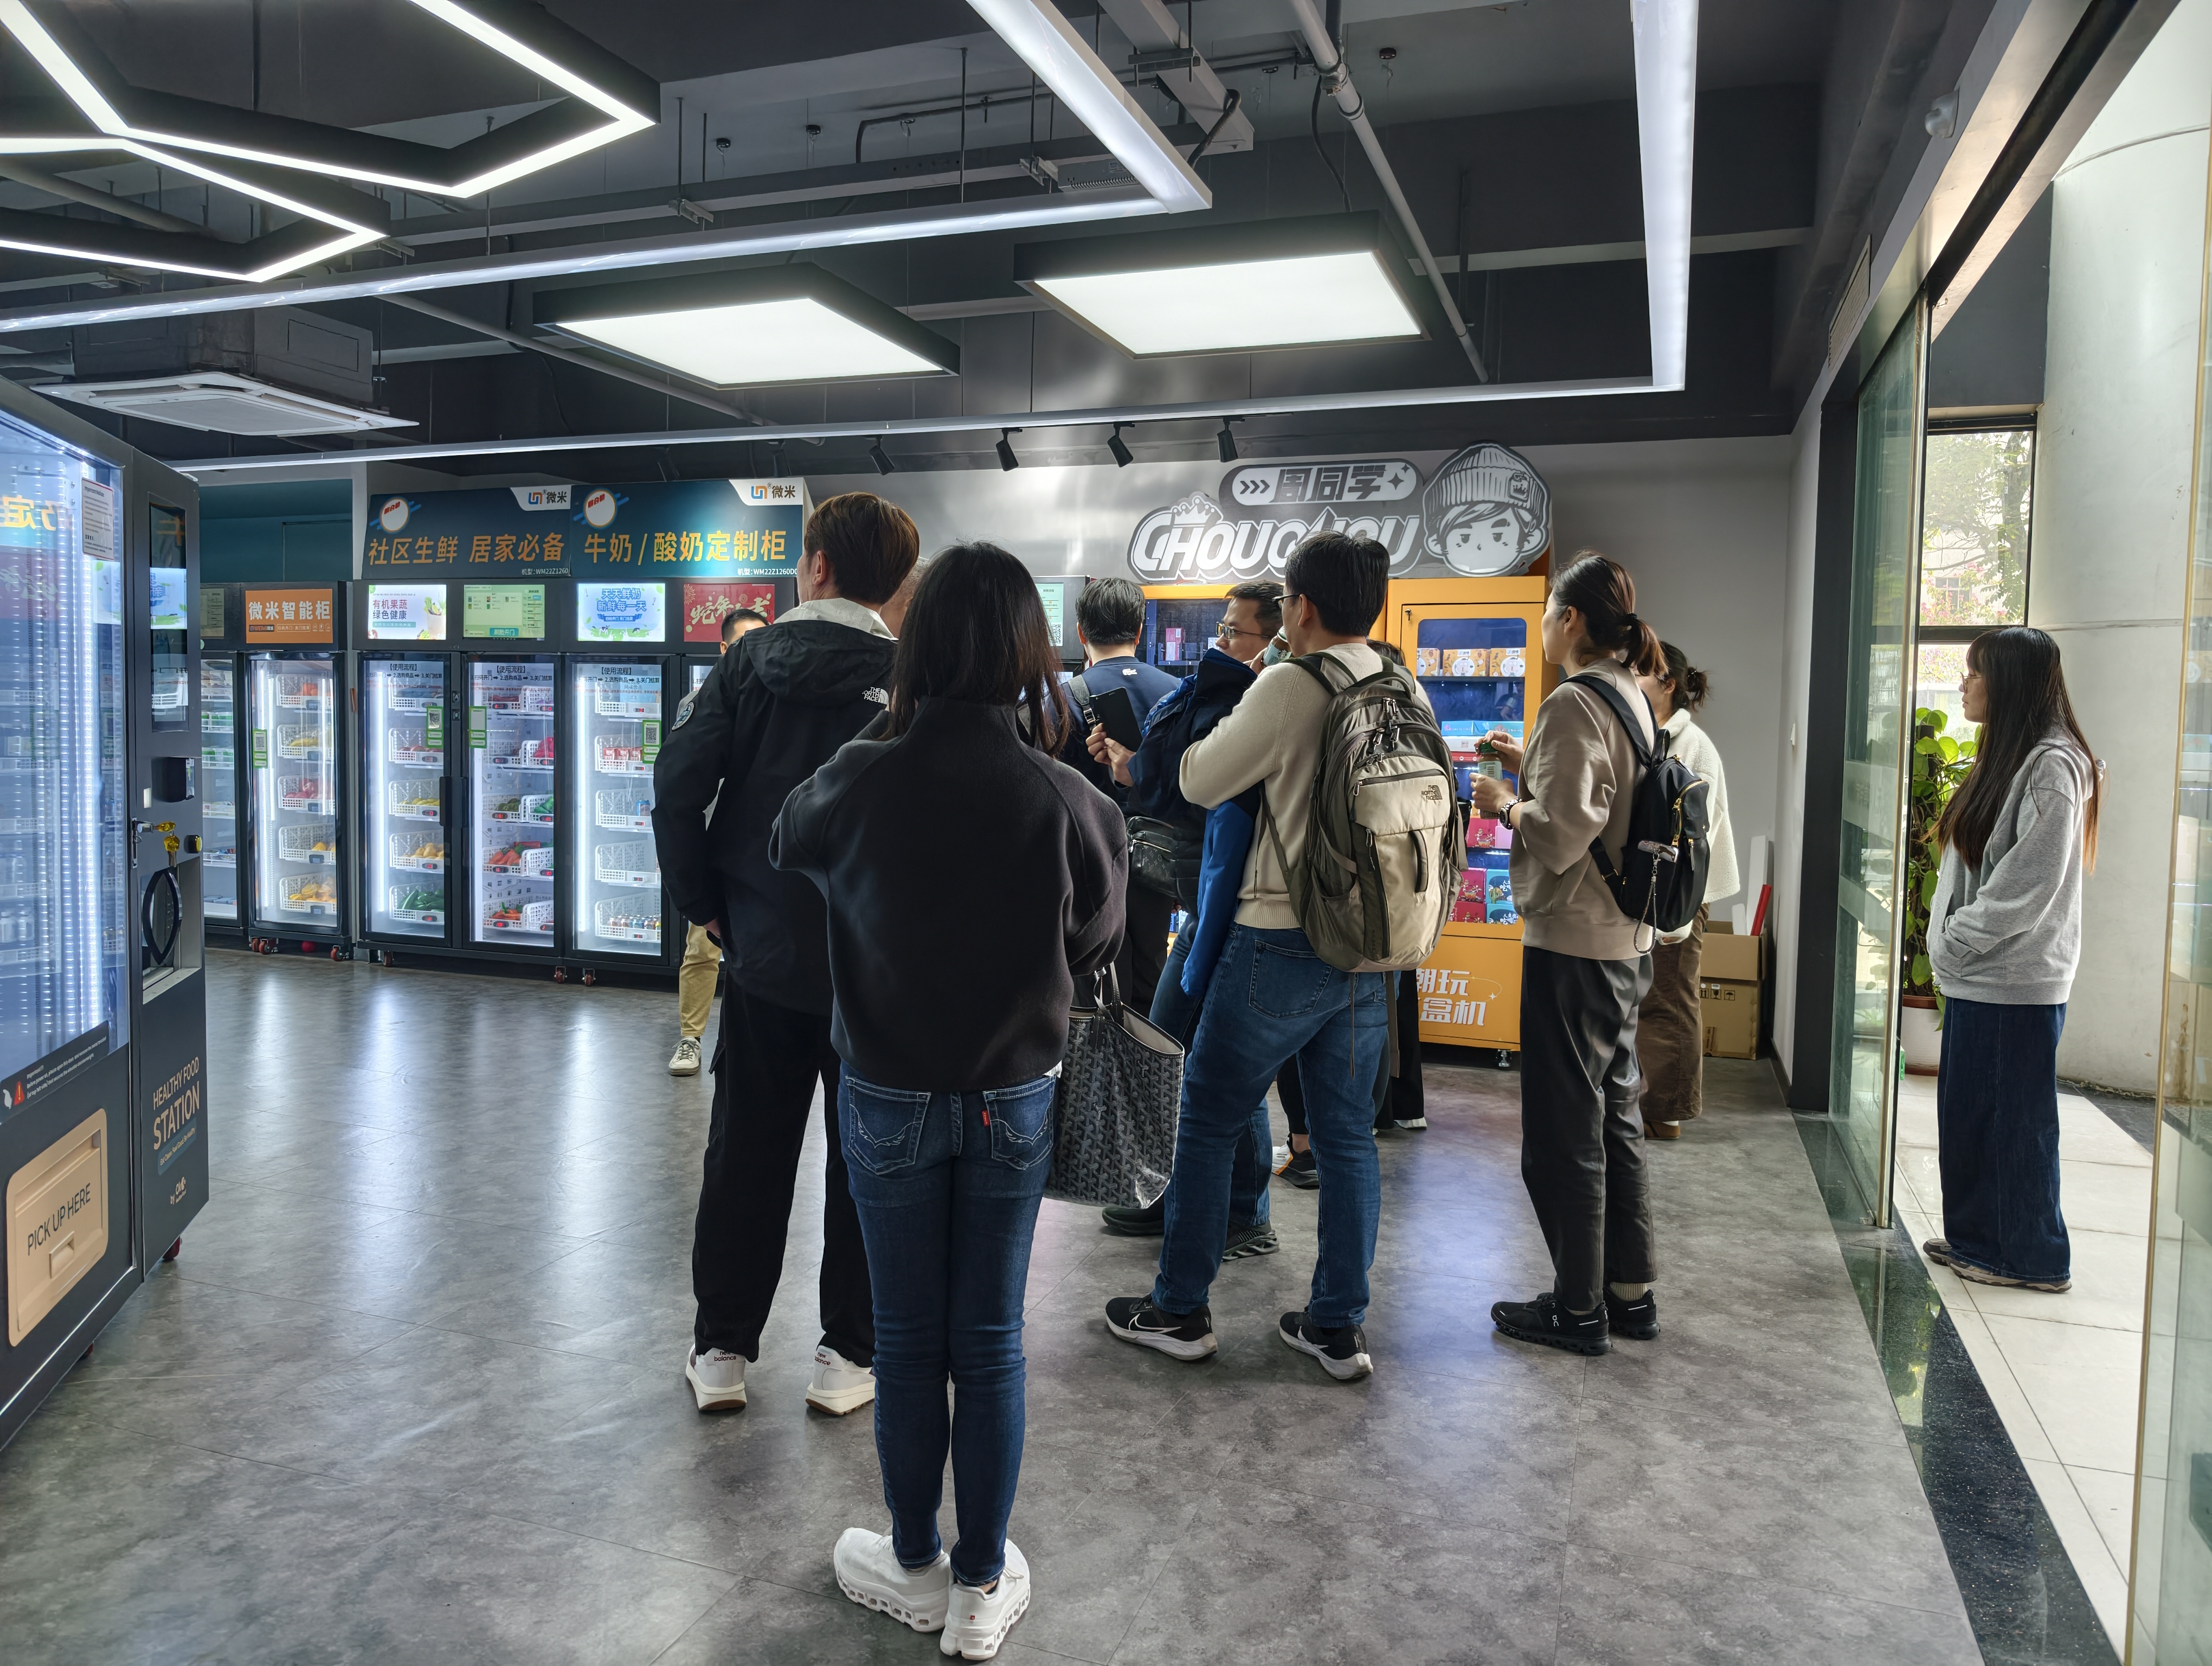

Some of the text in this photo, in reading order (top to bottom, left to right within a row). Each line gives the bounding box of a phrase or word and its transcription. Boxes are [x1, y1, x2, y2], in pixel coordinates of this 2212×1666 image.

[772, 485, 795, 498] 微米
[1269, 465, 1388, 503] 周同学
[546, 491, 567, 504] 微米
[369, 532, 565, 565] 社区生鲜 居家必备
[373, 599, 408, 610] 有机果蔬
[601, 588, 641, 599] 天天鲜奶
[249, 600, 330, 620] 微米智能柜
[373, 610, 407, 619] 绿色健康
[597, 600, 647, 612] 新鲜每一天
[690, 595, 770, 624] 蛇年吉
[1418, 997, 1486, 1026] 盒机
[153, 1057, 199, 1111] HEALTHY FOOD
[153, 1081, 200, 1150] STATION
[28, 1183, 91, 1256] PICK UP HERE
